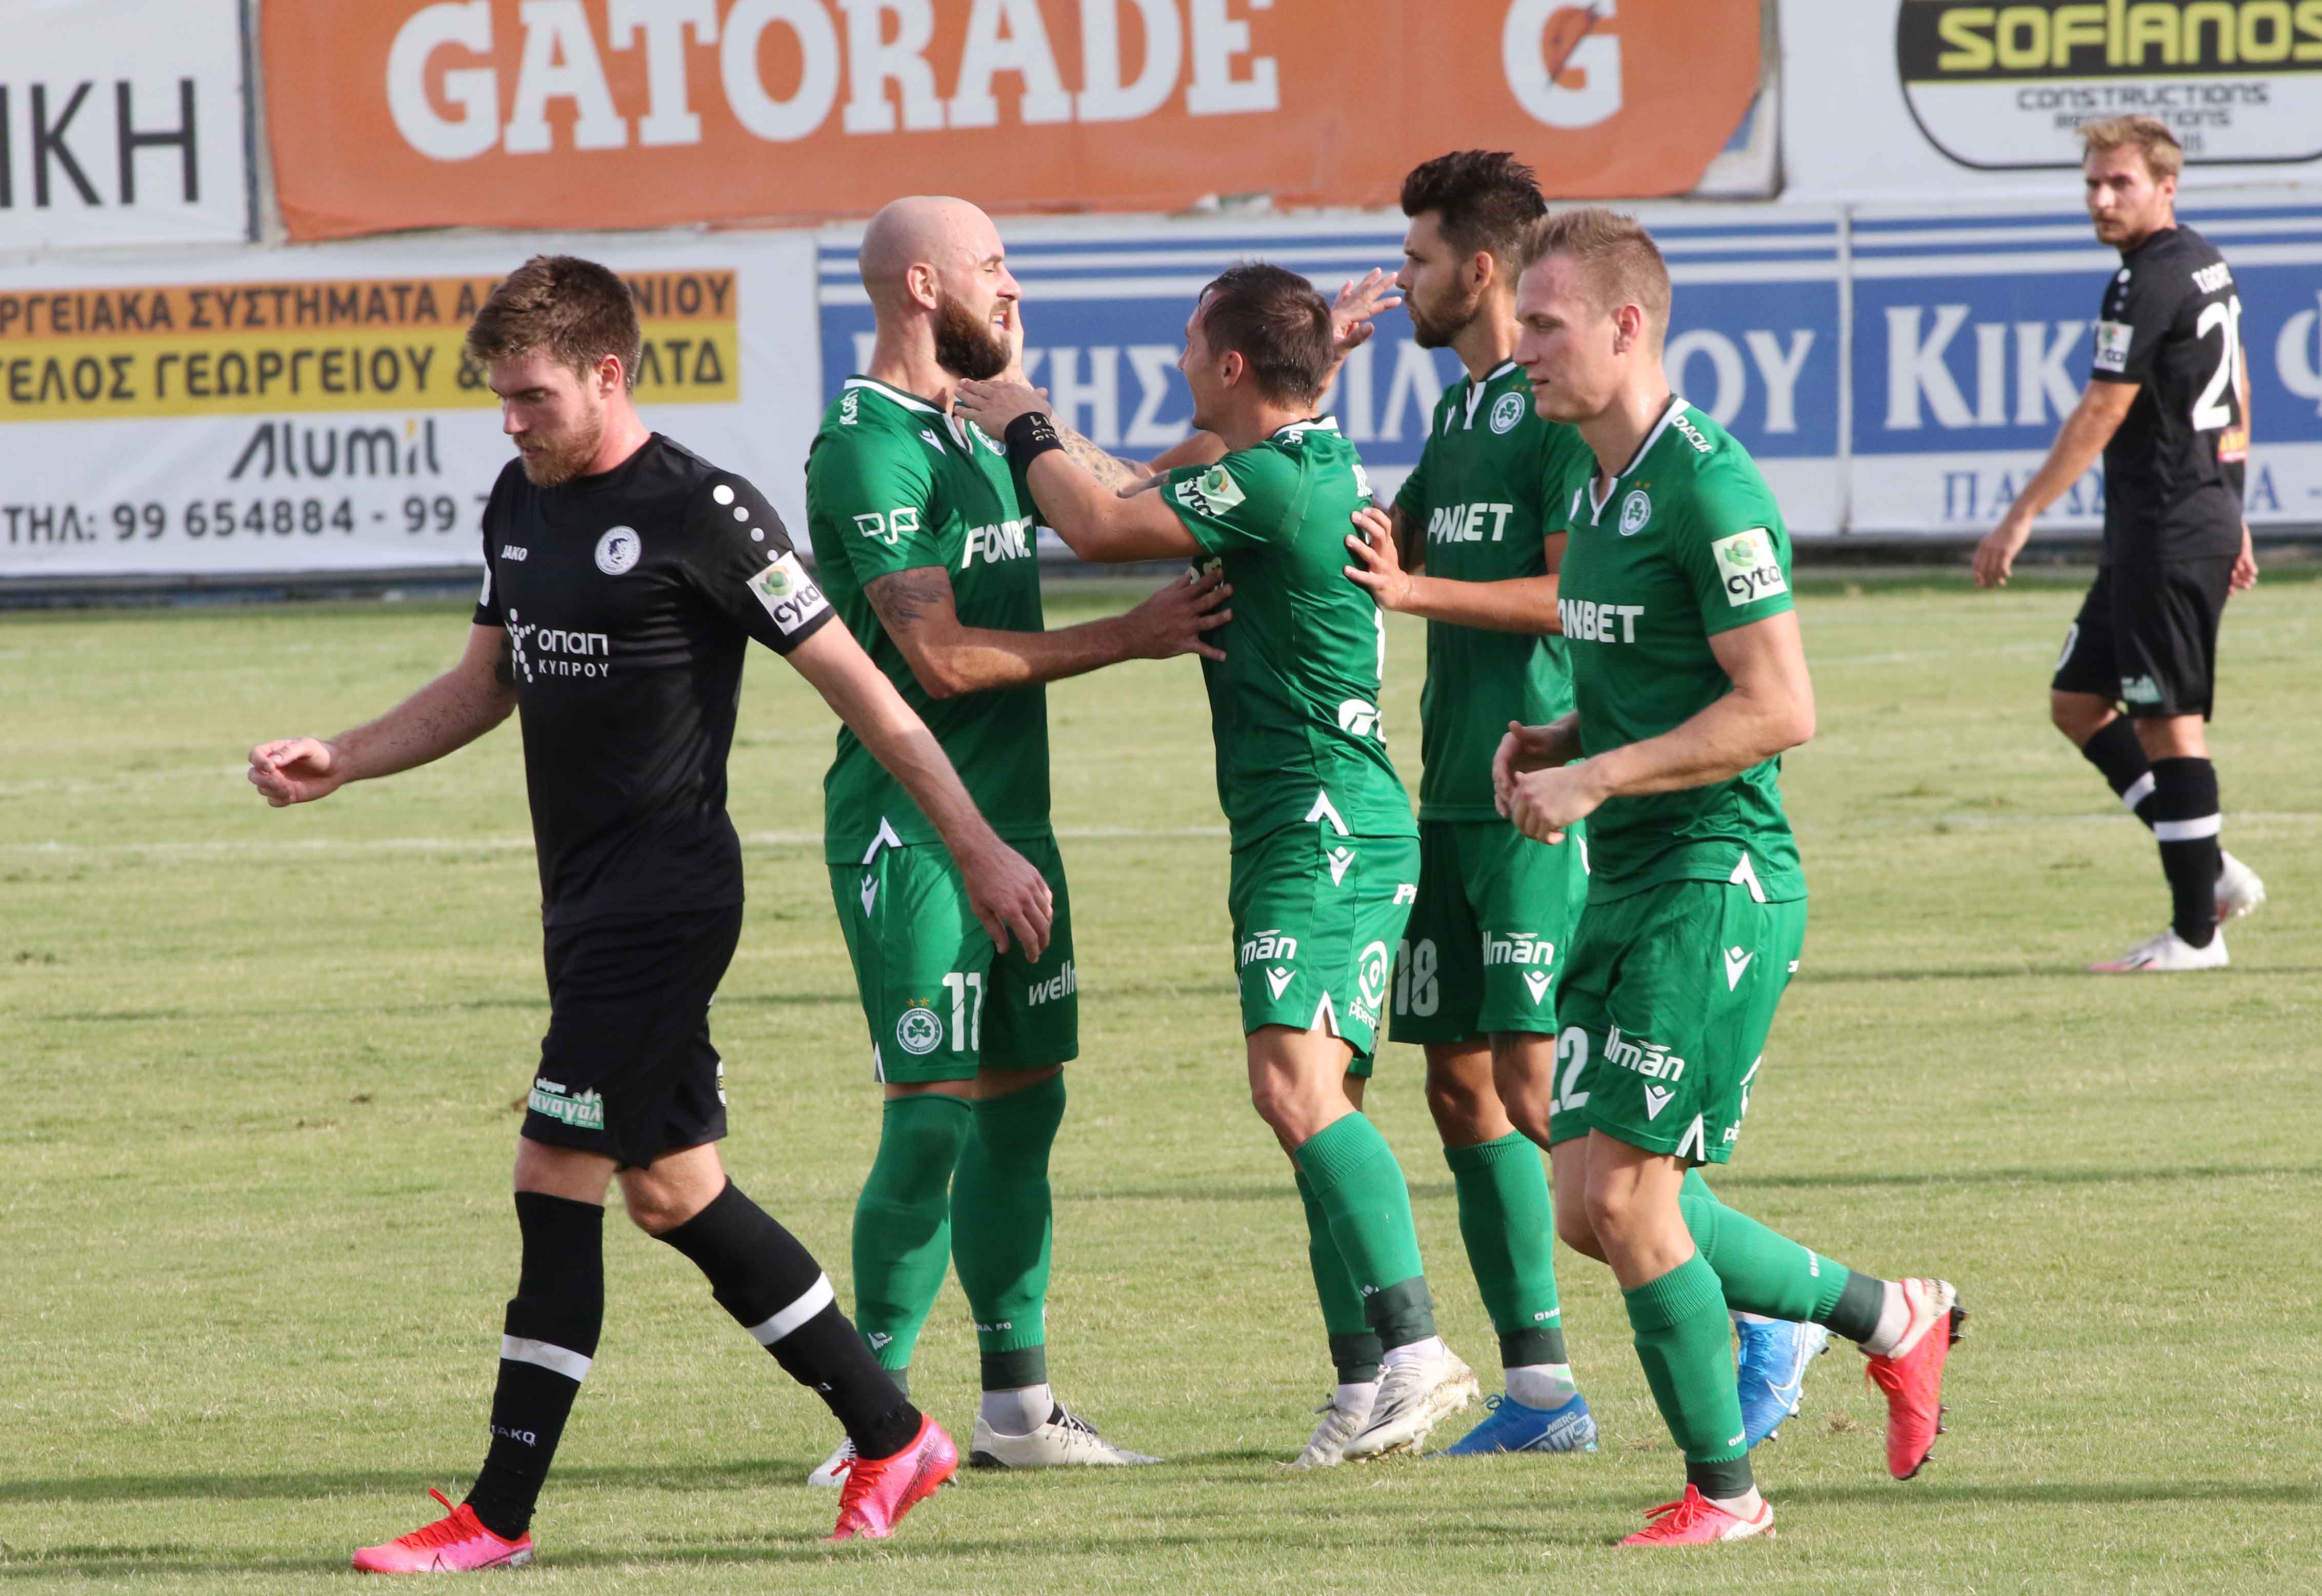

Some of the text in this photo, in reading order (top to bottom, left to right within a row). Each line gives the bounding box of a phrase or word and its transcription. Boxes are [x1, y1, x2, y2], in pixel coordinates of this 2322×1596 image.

[386, 0, 1281, 162] GATORADE
[1502, 0, 1623, 129] G
[189, 284, 438, 328] ΣΥΣΤΗΜΑΤΑ
[0, 354, 135, 402] ΕΛΟΣ
[156, 347, 434, 398] ΓΕΩΡΓΕΙΟΥ
[228, 418, 441, 480] Alumil
[5, 505, 97, 544] ΤΗΛ:
[112, 502, 167, 541] 99
[185, 496, 355, 538] 654884
[403, 495, 457, 535] 99
[501, 544, 528, 562] JAKO
[773, 583, 821, 624] cyta
[1728, 566, 1780, 600] cyta
